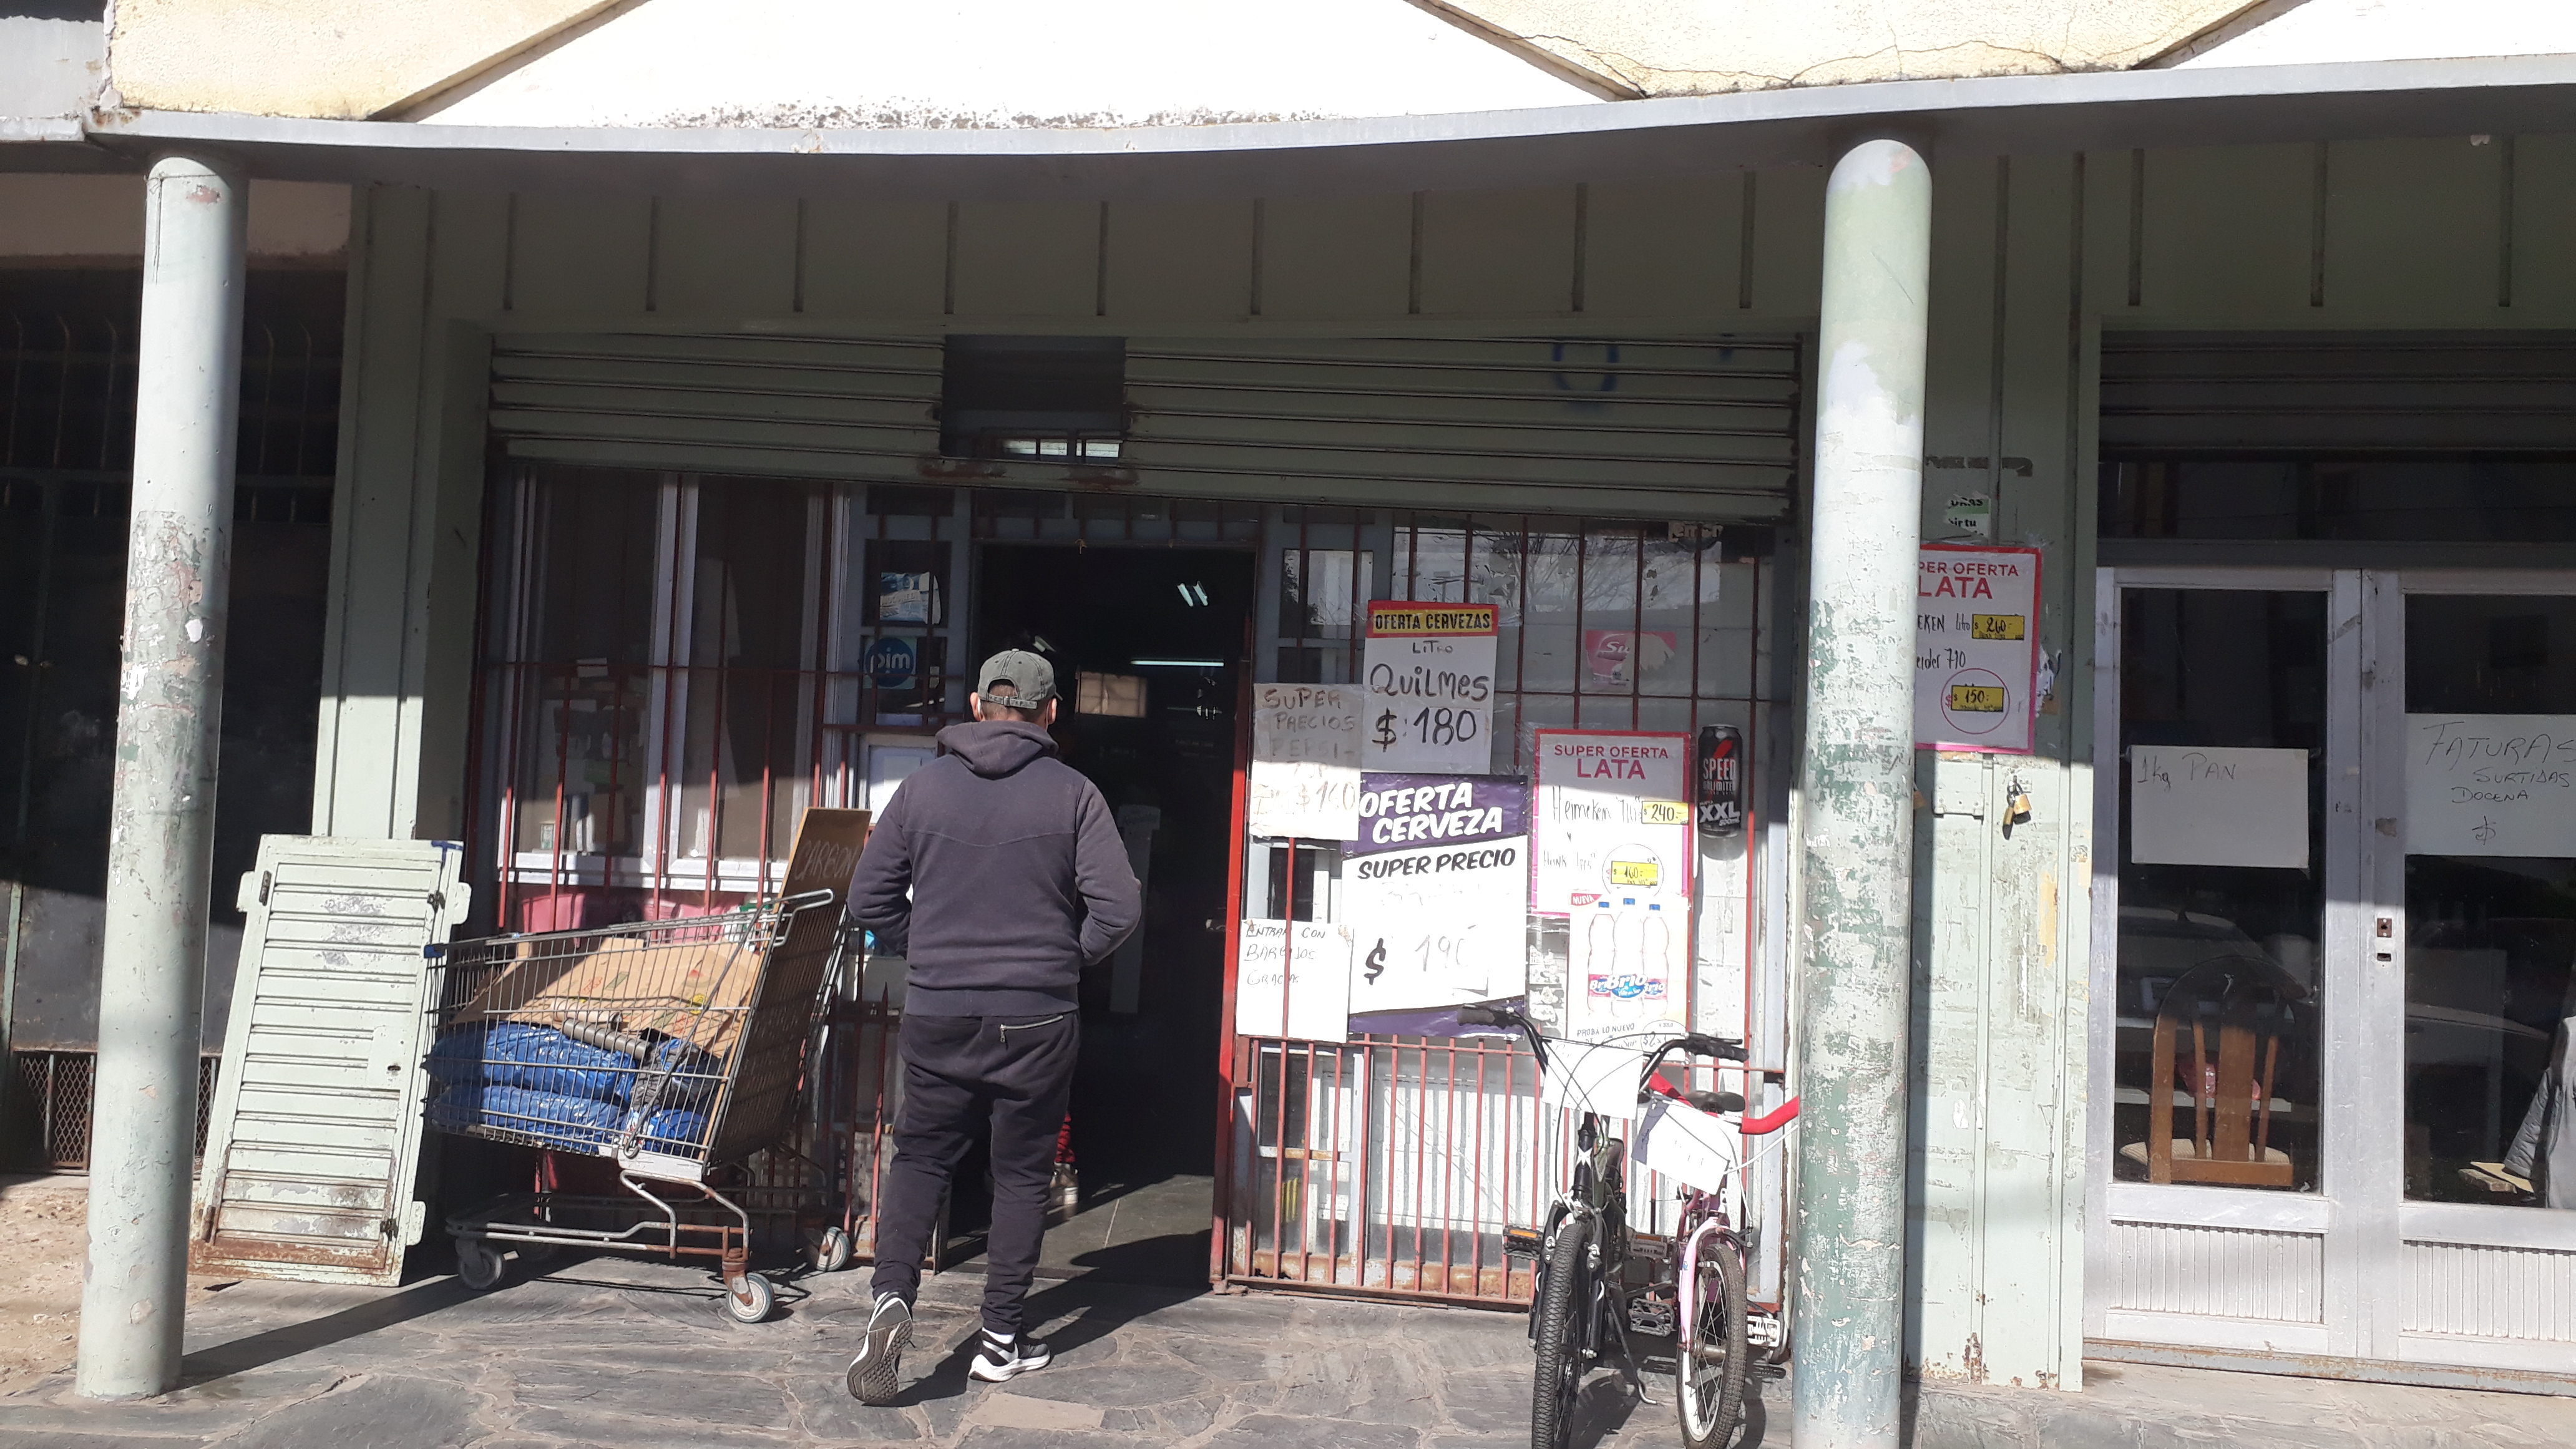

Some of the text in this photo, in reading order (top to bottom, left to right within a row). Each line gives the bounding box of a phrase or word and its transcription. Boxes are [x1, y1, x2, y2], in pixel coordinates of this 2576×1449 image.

[1918, 562, 2019, 576] PER OFERTA
[1918, 575, 1993, 599] LATA
[1375, 613, 1490, 630] OFERTA CERVEZAS
[869, 646, 911, 674] pim
[1944, 648, 1966, 670] 710
[1262, 687, 1341, 710] SUPER
[1274, 711, 1355, 733] PRECIOS
[1413, 707, 1477, 746] 180
[1554, 744, 1669, 759] SUPER OFERTA
[2422, 721, 2576, 771] FATURAS
[1577, 758, 1646, 779] LATA
[1703, 758, 1736, 780] SPEED
[2182, 752, 2236, 781] PAN
[2473, 767, 2570, 788] SURTIDAS
[1359, 782, 1473, 817] OFERTA
[2451, 786, 2530, 803] DOCENA
[1699, 801, 1741, 823] XXL
[1372, 807, 1503, 844] CERVEZA
[1357, 847, 1516, 879] SUPER PRECIO
[1573, 895, 1595, 905] NUEVA
[1301, 927, 1325, 939] CON
[1364, 937, 1387, 986] $
[1247, 970, 1300, 986] GRACAS
[1611, 1023, 1636, 1033] NUEVO
